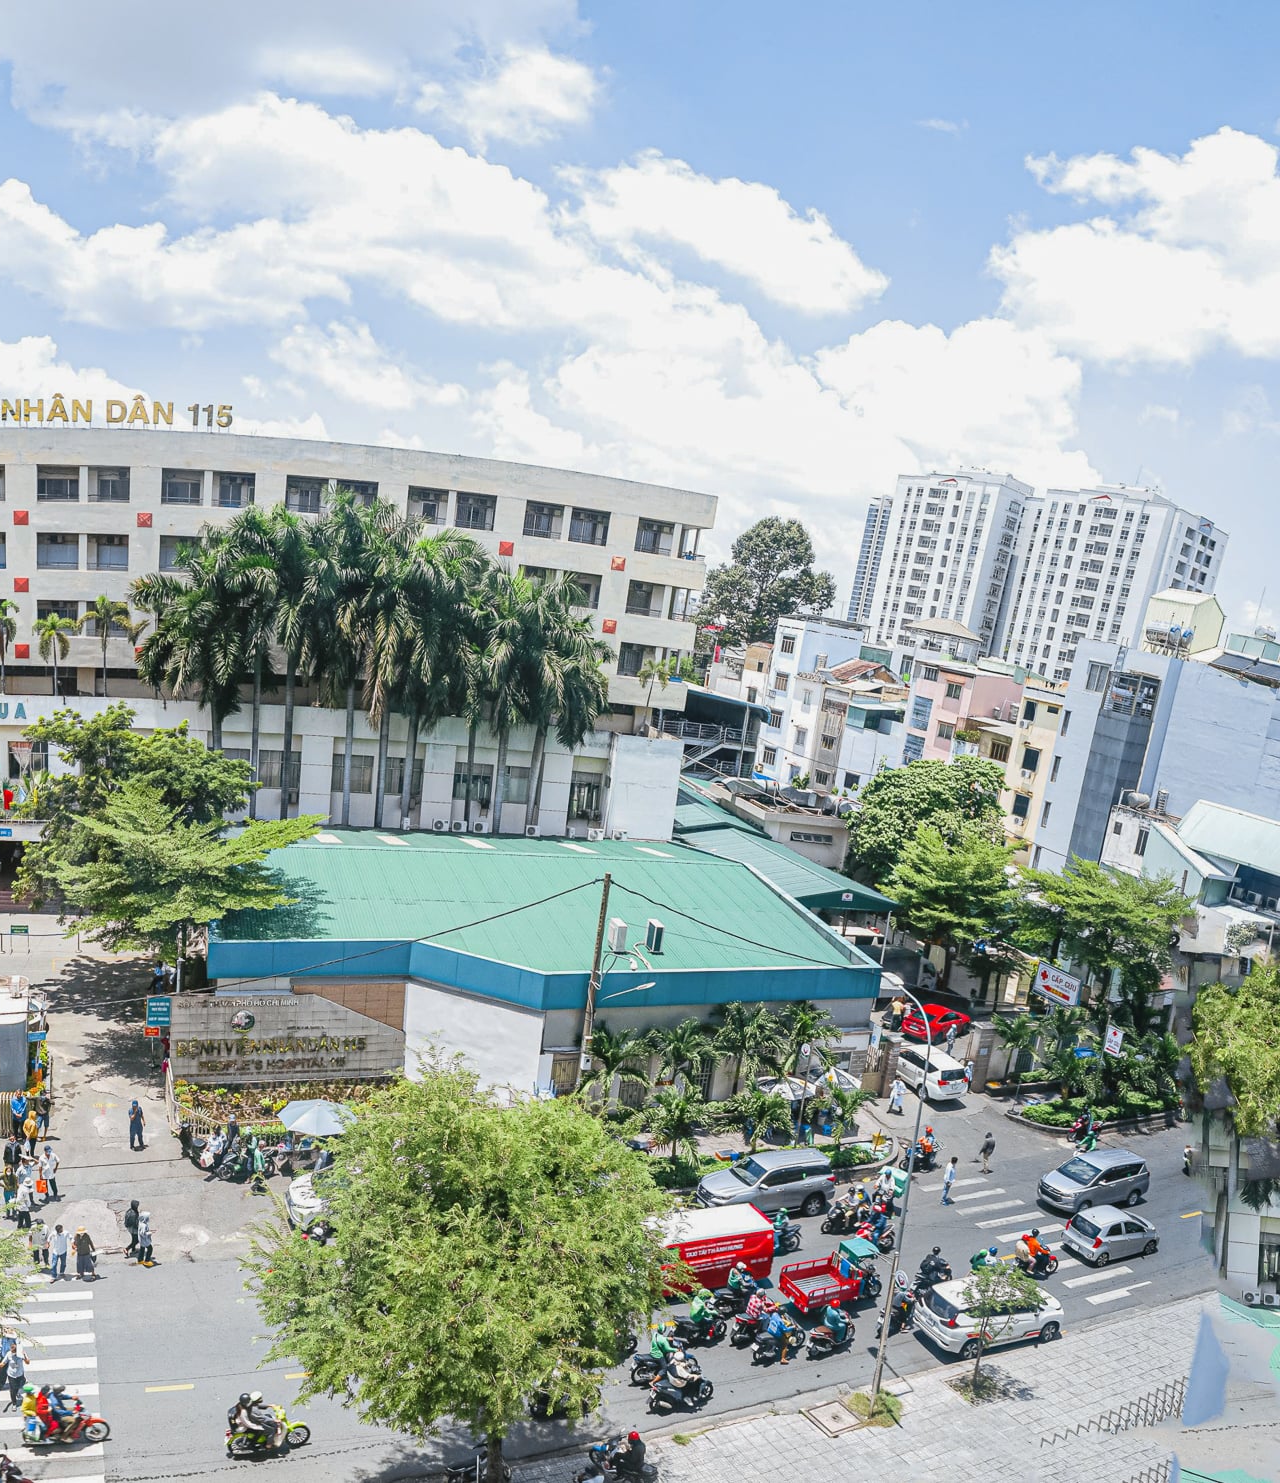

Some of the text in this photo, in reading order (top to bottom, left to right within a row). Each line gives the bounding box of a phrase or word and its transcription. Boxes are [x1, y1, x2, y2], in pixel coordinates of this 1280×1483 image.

[1, 392, 92, 422] NHÂN
[106, 394, 174, 424] DÂN
[187, 403, 233, 427] 115
[14, 702, 27, 719] A
[1051, 973, 1064, 984] CẤP
